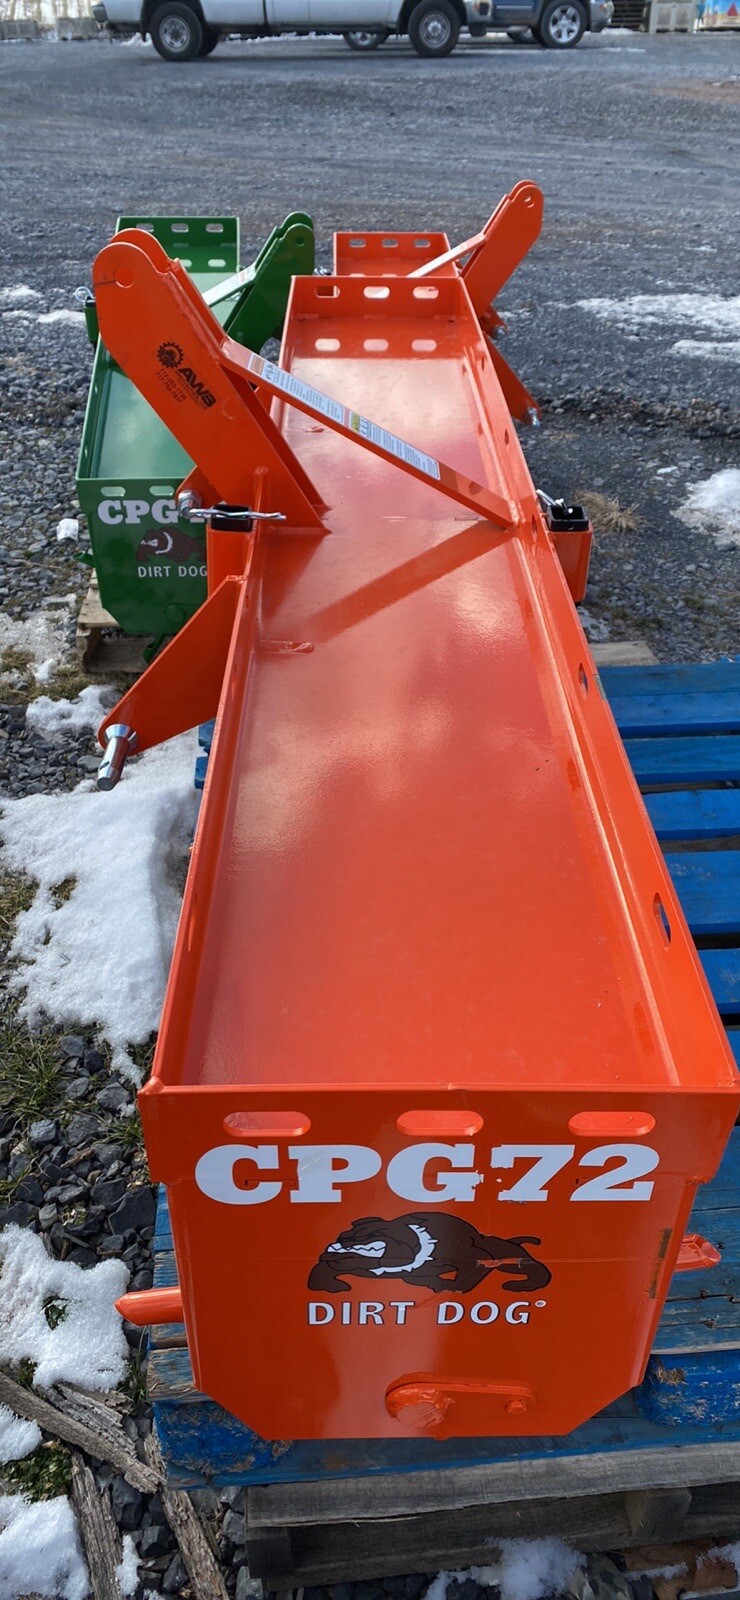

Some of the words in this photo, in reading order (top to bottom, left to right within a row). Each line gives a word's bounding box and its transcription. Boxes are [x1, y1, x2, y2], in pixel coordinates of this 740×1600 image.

[178, 367, 216, 407] AWB
[137, 565, 172, 578] DIRT
[178, 565, 207, 577] DOG
[194, 1142, 660, 1205] CPG72
[308, 1301, 415, 1326] DIRT
